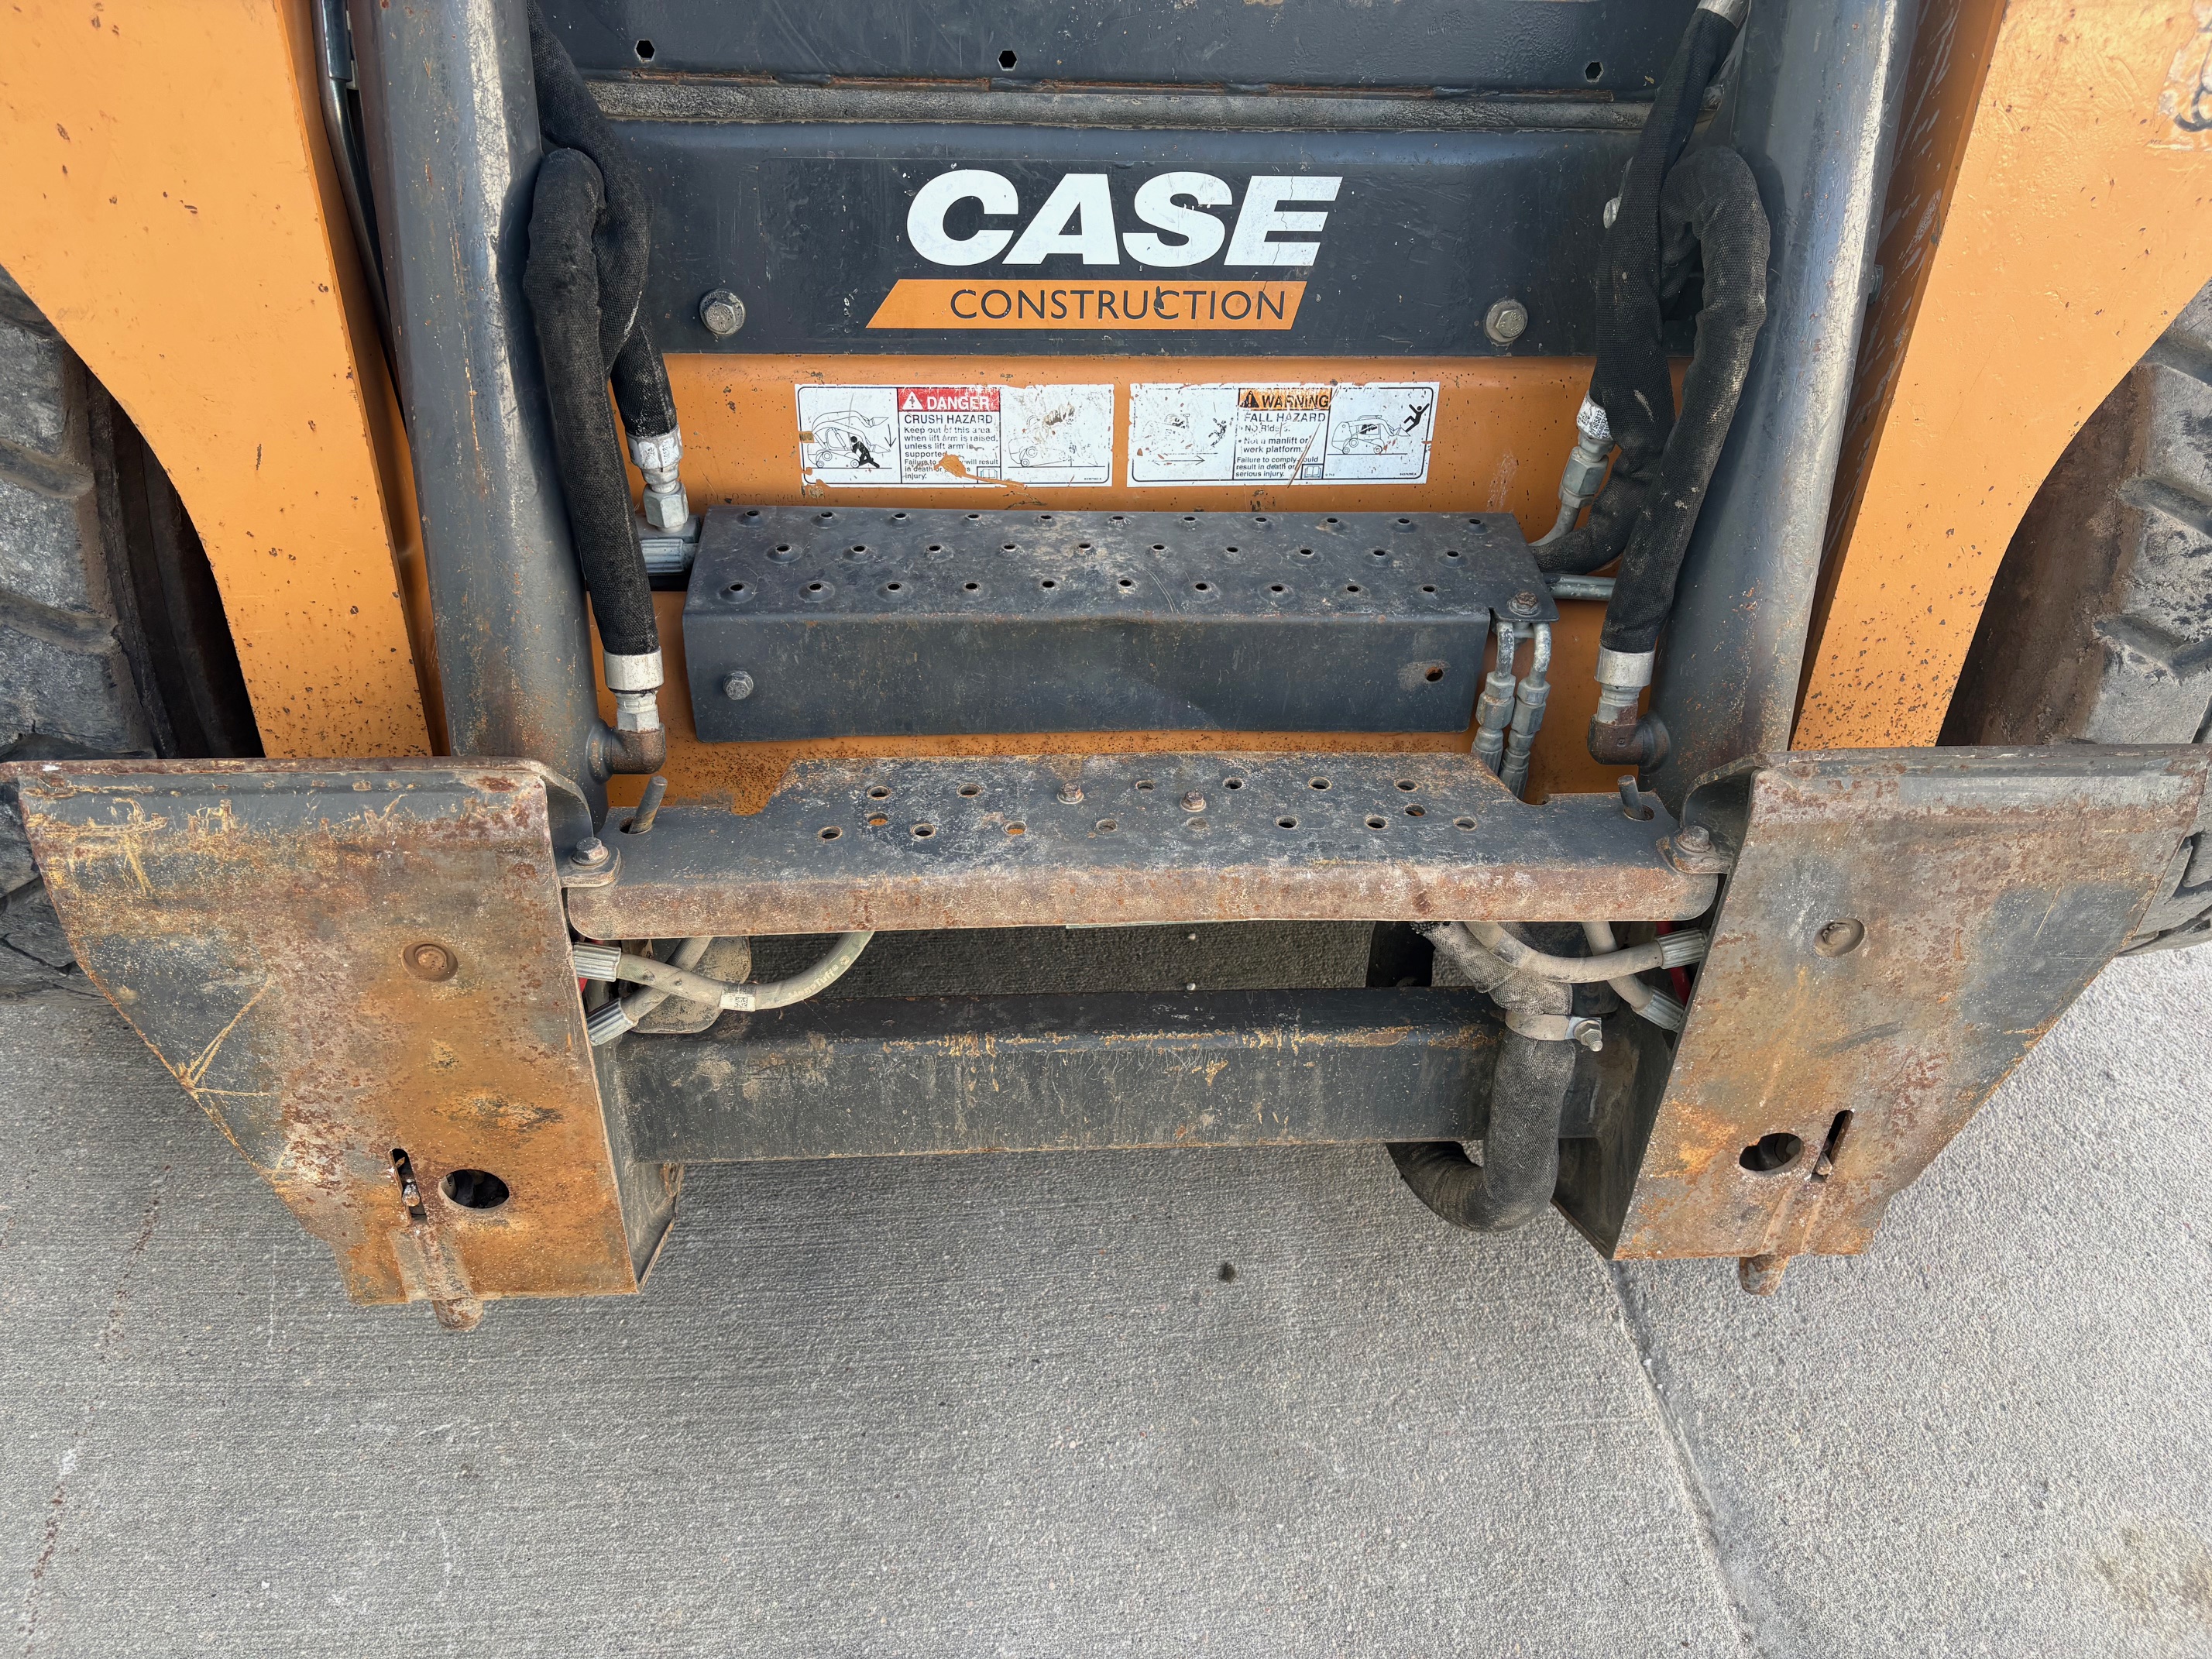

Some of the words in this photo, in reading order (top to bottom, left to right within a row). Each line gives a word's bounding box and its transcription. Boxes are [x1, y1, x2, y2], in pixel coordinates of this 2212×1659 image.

[906, 169, 1344, 267] CASE
[950, 288, 1285, 321] CONSTRUCTION
[926, 396, 990, 410] DANGER
[1262, 394, 1329, 408] WARNING
[904, 414, 943, 424] CRUSH
[946, 414, 993, 424] HAZARD
[1244, 412, 1273, 422] FALL
[1276, 412, 1326, 422] HAZARD
[904, 427, 926, 435] Keep
[1266, 445, 1304, 454] platform.
